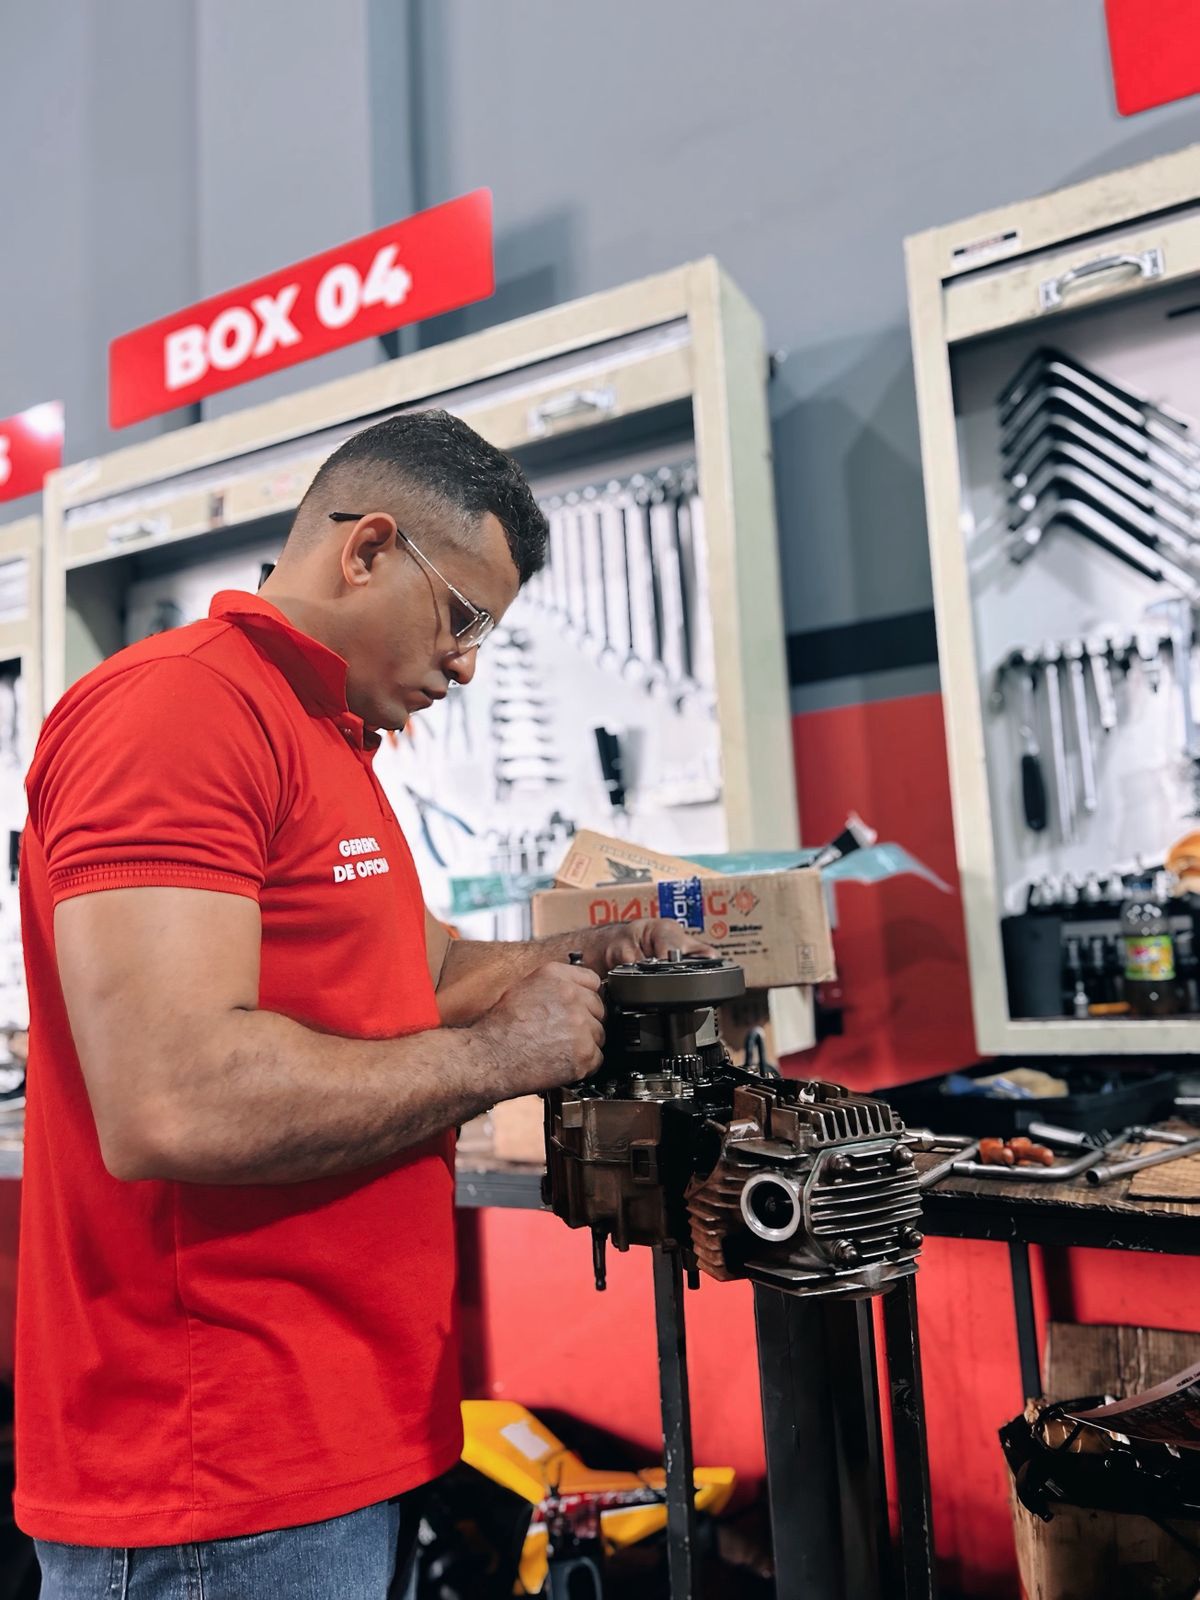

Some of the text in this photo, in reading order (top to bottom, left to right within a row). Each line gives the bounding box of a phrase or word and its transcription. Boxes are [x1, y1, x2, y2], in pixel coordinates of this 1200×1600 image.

[164, 242, 412, 392] BOX 04
[333, 863, 357, 883] DE
